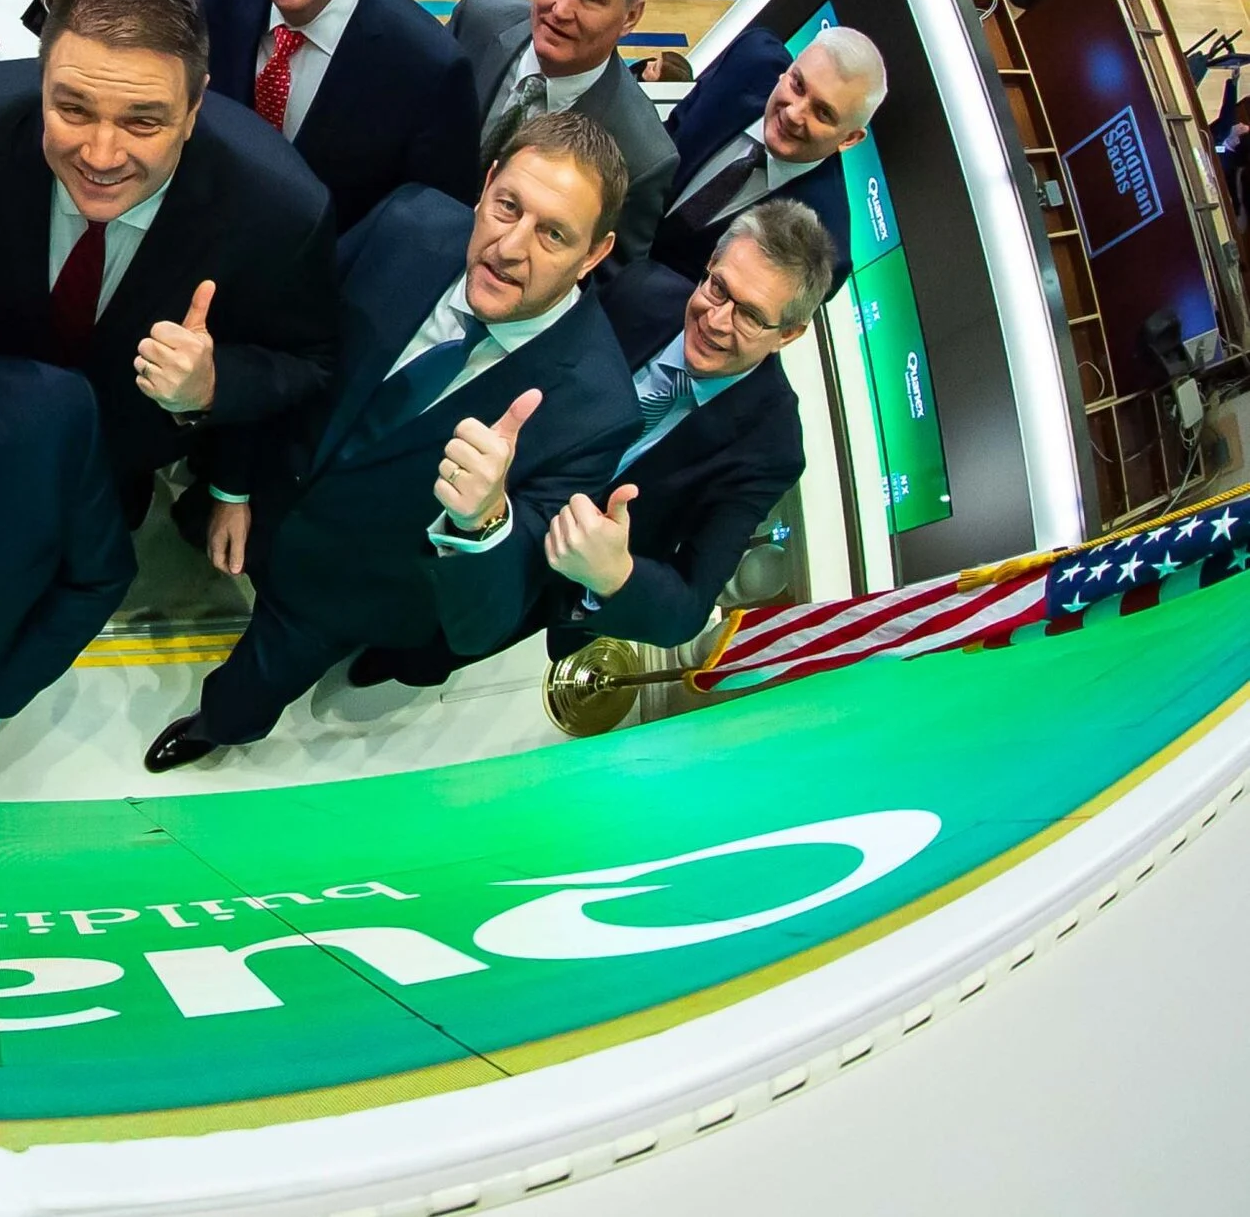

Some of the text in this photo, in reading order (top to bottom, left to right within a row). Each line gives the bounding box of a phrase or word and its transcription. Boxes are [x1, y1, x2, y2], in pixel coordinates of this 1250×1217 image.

[1102, 129, 1131, 195] Sachs
[1114, 119, 1154, 218] Goldman
[868, 177, 889, 241] Quanex
[907, 351, 925, 419] Quanex
